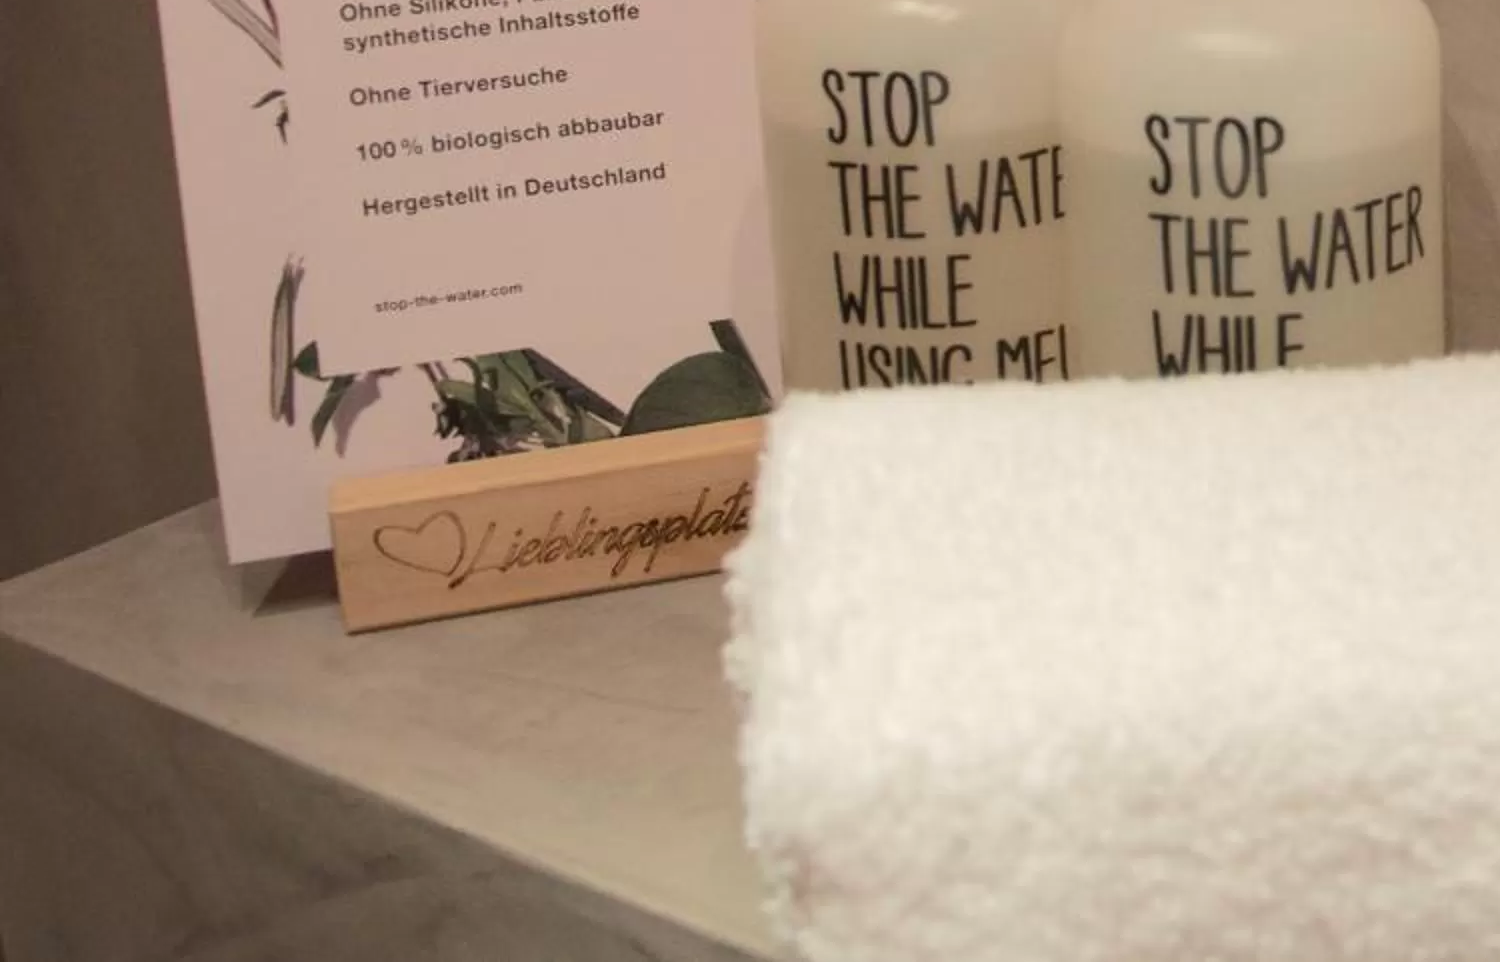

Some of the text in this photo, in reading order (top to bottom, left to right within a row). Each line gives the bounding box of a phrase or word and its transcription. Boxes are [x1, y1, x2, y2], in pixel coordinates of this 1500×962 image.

[339, 1, 402, 23] Ohne
[342, 2, 641, 54] synthetische Inhaltsstoffe
[349, 66, 569, 107] Ohne Tierversuche
[821, 68, 951, 149] STOP
[356, 140, 397, 161] 100
[430, 122, 551, 153] biologisch
[557, 111, 666, 138] abbaubar
[1143, 112, 1285, 200] STOP
[362, 161, 667, 217] Hergestellt in Deutschland
[827, 143, 1067, 241] THE WATE
[1147, 183, 1425, 299] THE WATER
[374, 282, 524, 314] stop-the-water.com
[833, 251, 978, 331] WHILE
